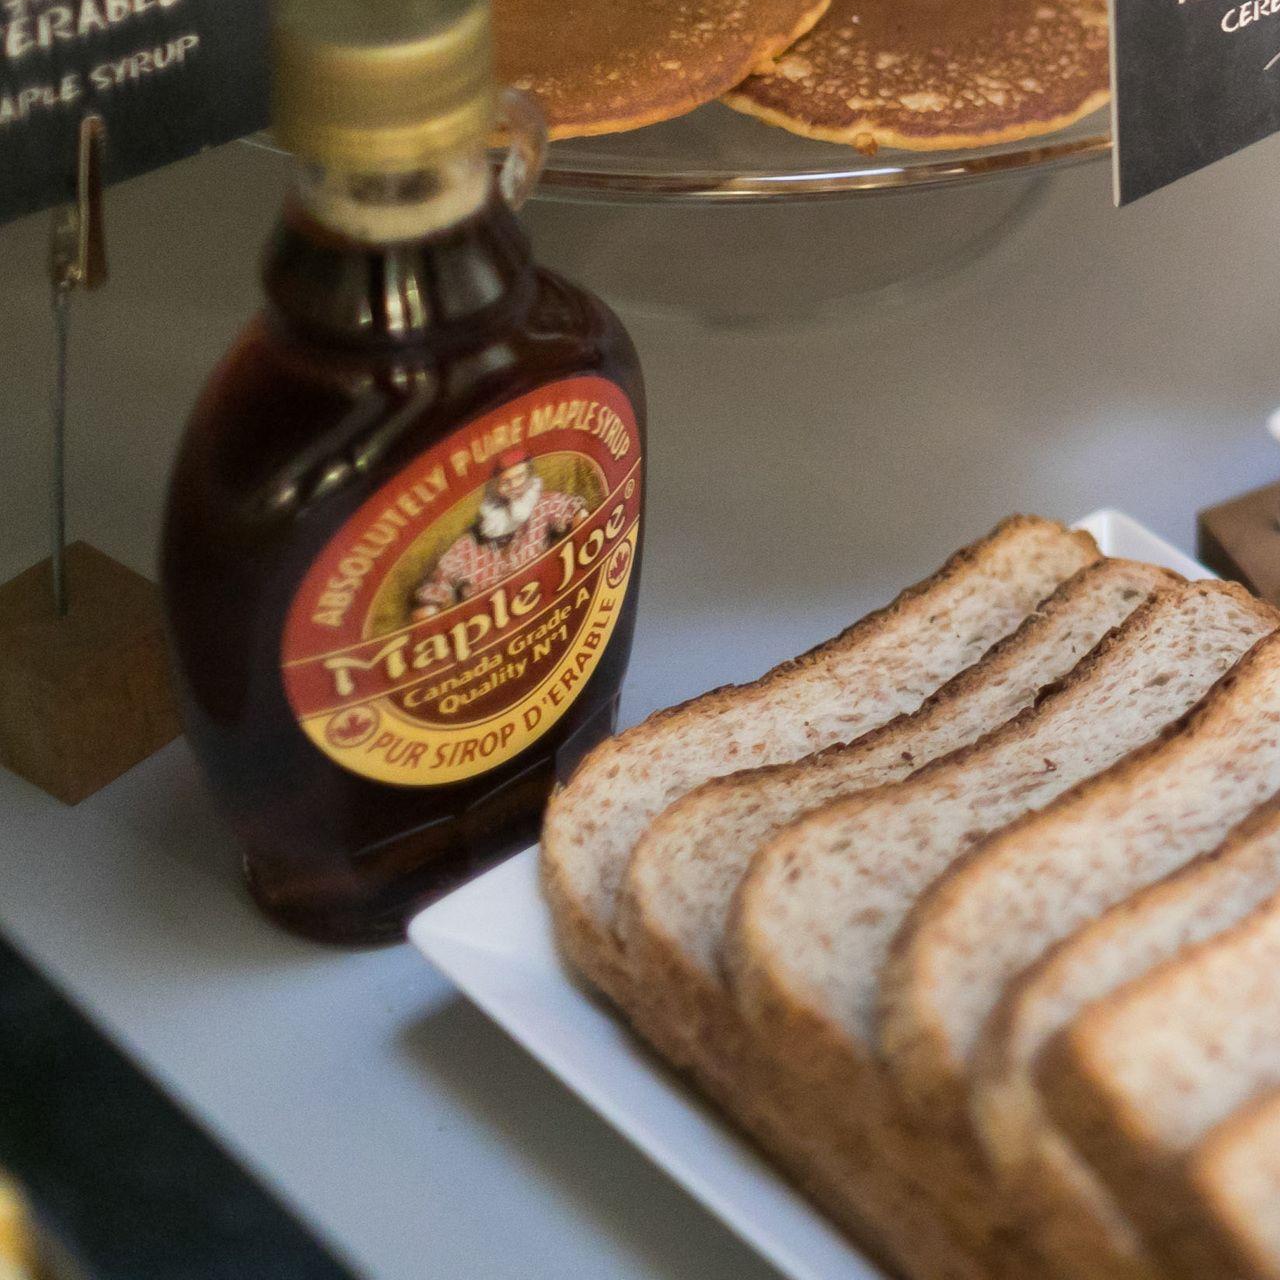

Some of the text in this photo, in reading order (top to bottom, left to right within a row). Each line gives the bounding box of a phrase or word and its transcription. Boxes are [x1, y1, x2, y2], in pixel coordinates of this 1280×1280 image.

[89, 34, 200, 90] SYRUP
[312, 399, 632, 628] ABSOLUTELY PURE MAPLE SYRUP
[323, 580, 542, 697] Maple
[403, 586, 592, 709] Canada Grade A
[438, 658, 528, 715] Quality
[366, 731, 429, 769] PUR
[429, 722, 515, 769] SIROP
